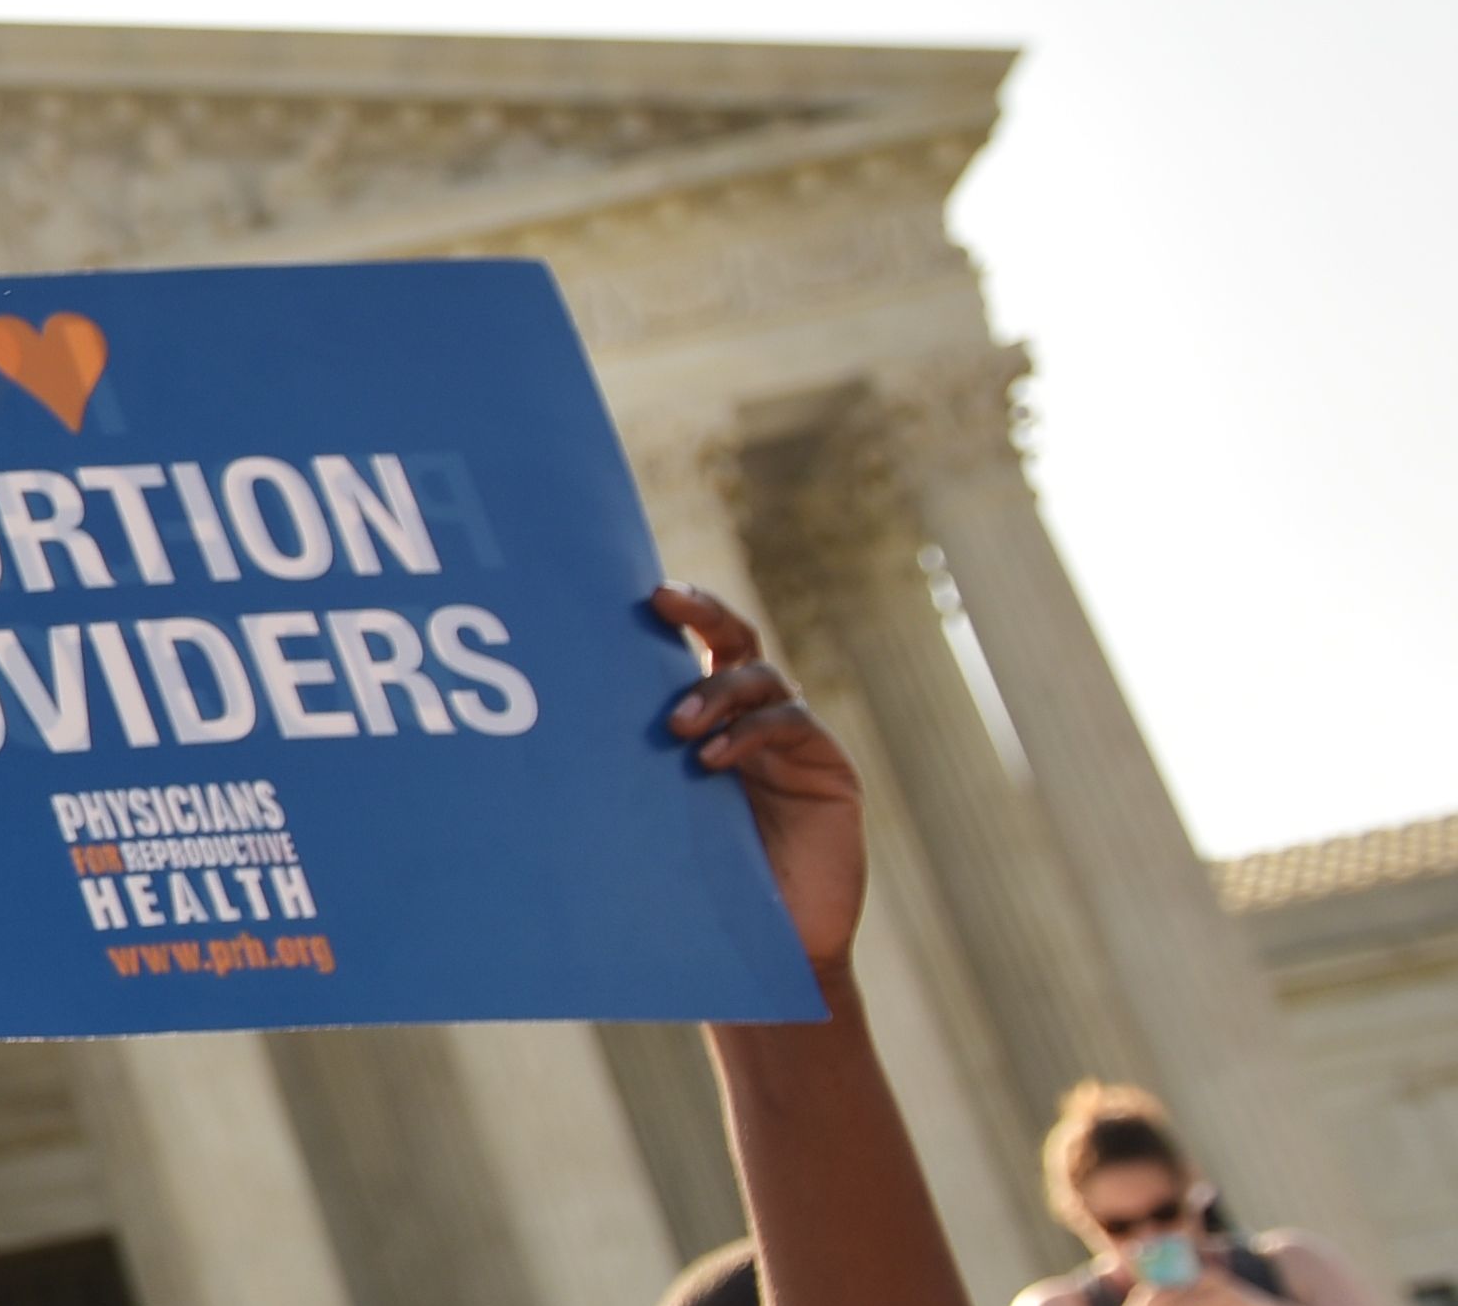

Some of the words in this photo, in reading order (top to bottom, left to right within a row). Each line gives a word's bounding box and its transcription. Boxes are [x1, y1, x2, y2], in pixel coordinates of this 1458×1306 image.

[49, 779, 287, 844] PHYSICIANS
[69, 843, 125, 876] FOR
[121, 831, 299, 873] REPRODUCTIVE
[80, 865, 319, 931] HEALTH
[106, 932, 336, 977] www.prh.org
